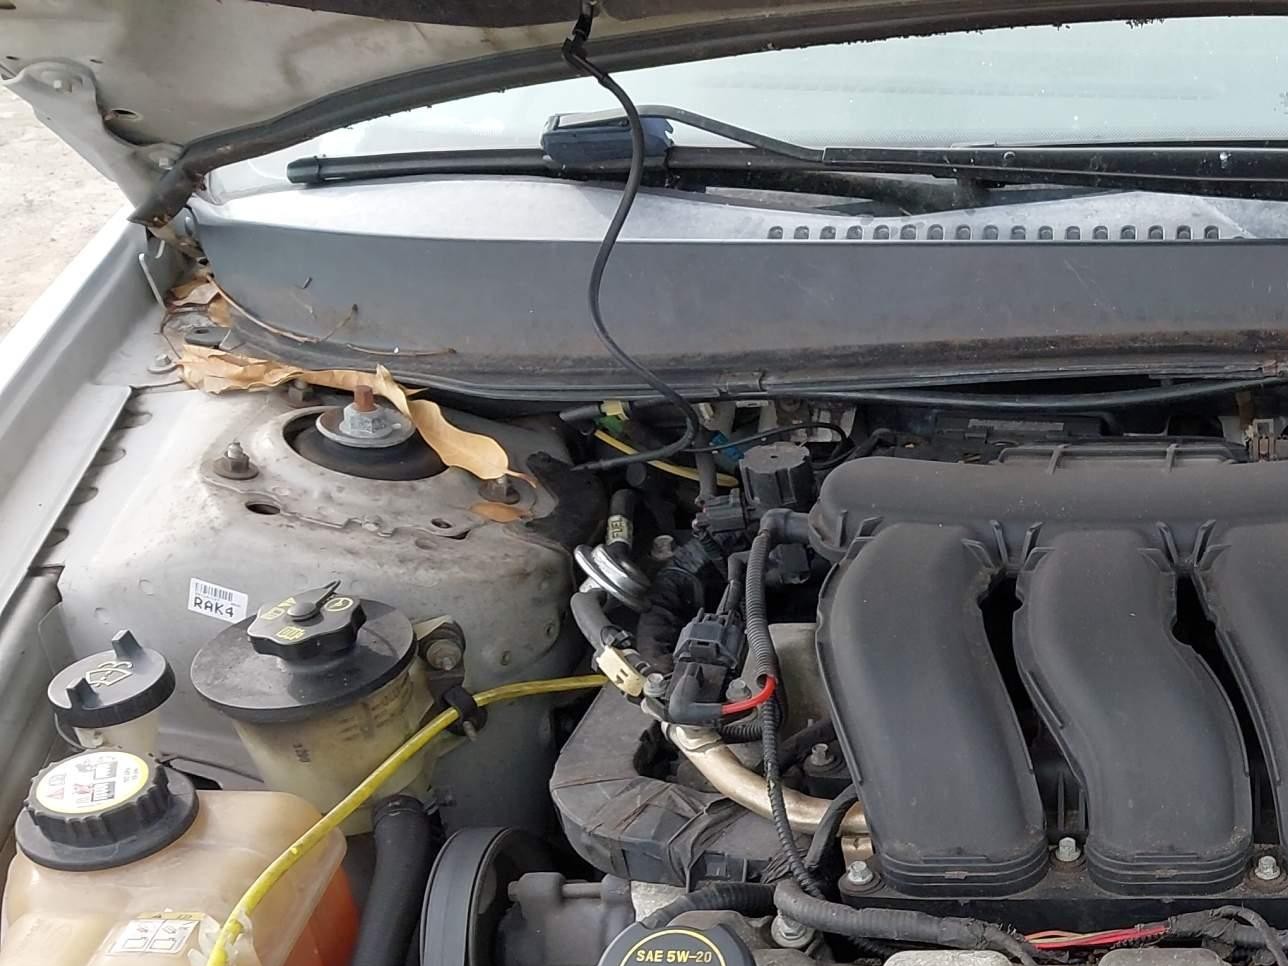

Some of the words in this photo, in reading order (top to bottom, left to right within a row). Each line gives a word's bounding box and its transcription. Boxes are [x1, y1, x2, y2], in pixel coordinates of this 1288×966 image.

[193, 596, 234, 618] RAK4
[636, 950, 663, 963] SAE
[666, 950, 712, 963] 5W-20
